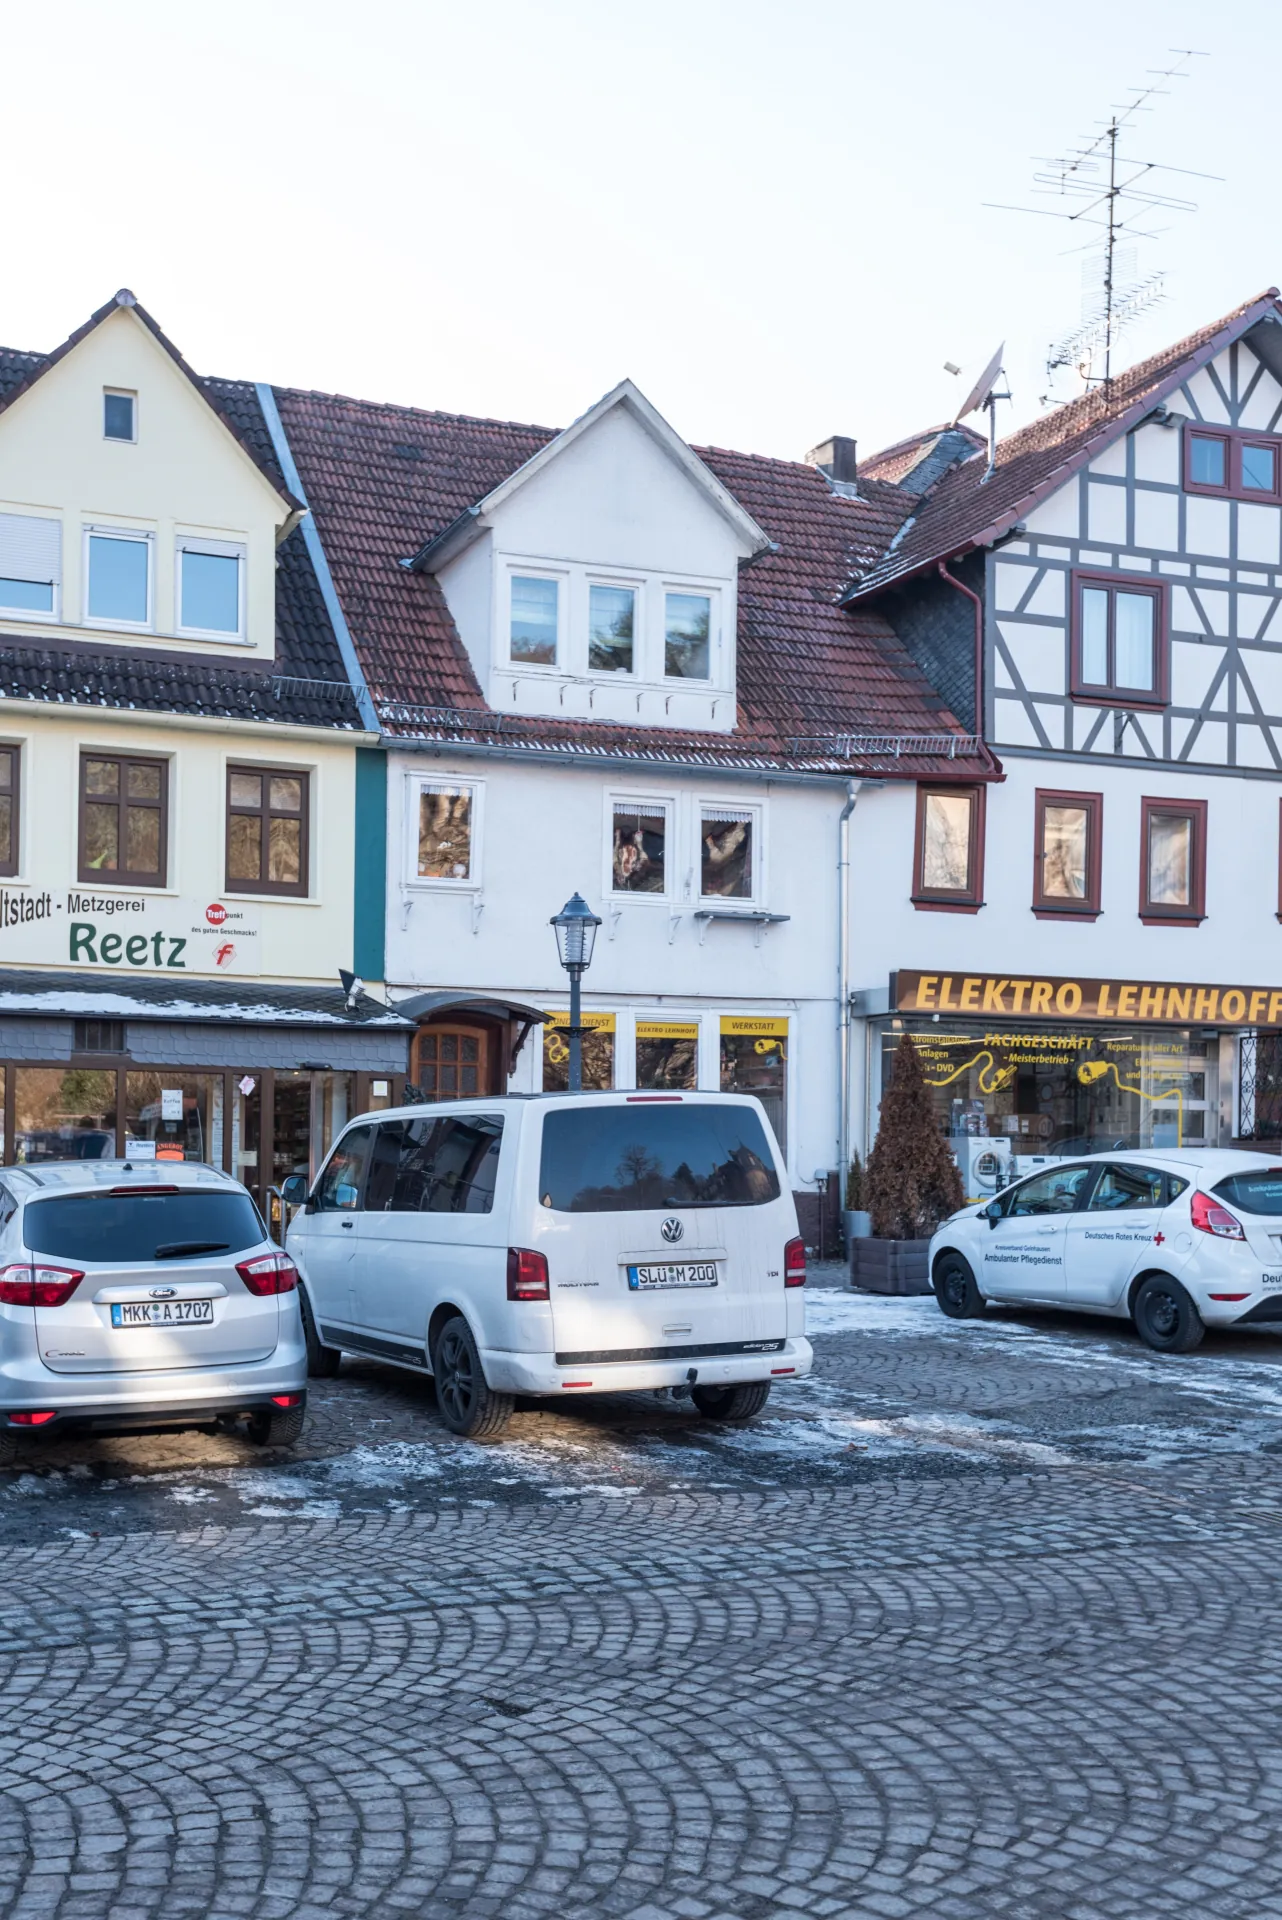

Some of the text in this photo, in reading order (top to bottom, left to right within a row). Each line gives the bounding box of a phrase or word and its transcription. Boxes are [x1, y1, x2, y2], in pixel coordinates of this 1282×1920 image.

[0, 889, 51, 928] ltstadt
[68, 894, 145, 915] Metzgerei
[206, 909, 243, 919] Treffpunkt
[220, 928, 257, 936] Geschmacks!
[69, 922, 187, 968] Reetz
[916, 976, 1282, 1023] ELEKTRO LEHNHOFF
[732, 1022, 775, 1030] WERKSTATT
[984, 1033, 1094, 1050] FACHGESCHÄFT
[1008, 1053, 1069, 1064] Meisterbetrieb
[936, 1063, 955, 1072] DVD
[1085, 1231, 1152, 1241] Deutsches Rotes Kreuz
[984, 1253, 1062, 1265] Ambulanter Pflegedienst
[639, 1268, 667, 1283] SLÜ
[688, 1265, 715, 1281] 200
[123, 1305, 152, 1321] MKK
[164, 1304, 172, 1320] A
[175, 1302, 210, 1319] 1707
